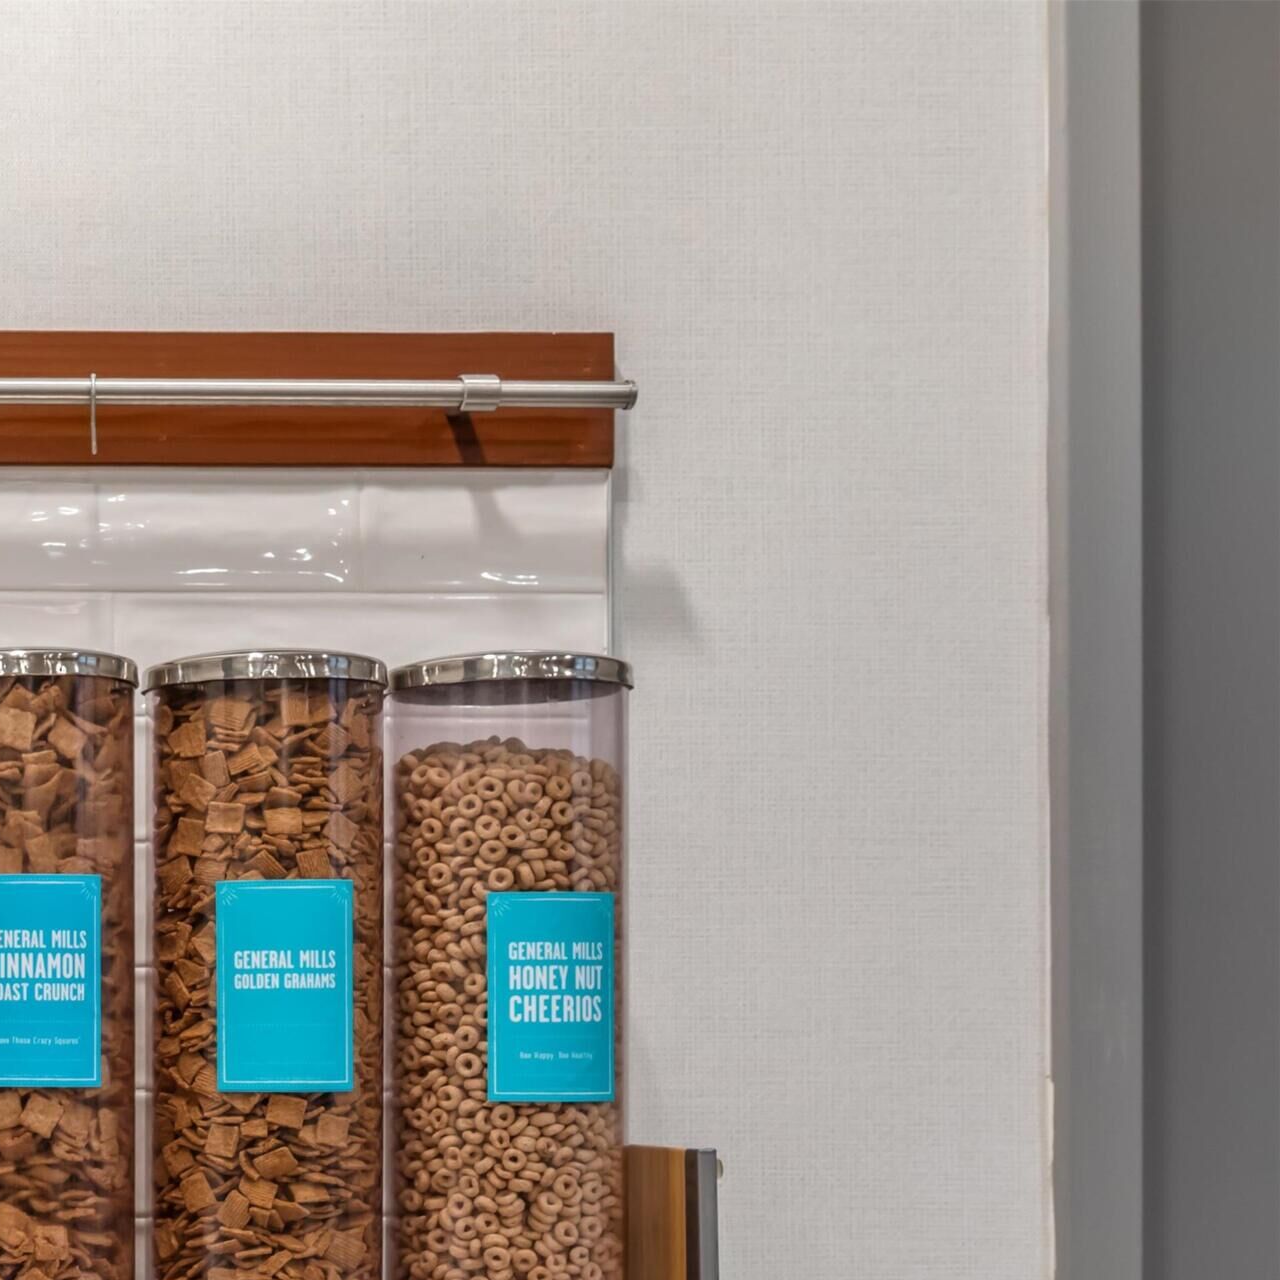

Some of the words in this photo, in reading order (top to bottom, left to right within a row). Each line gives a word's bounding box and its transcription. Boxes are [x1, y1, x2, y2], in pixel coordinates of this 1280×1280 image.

[51, 929, 87, 949] MILLS
[233, 949, 295, 970] GENERAL
[299, 950, 336, 969] MILLS
[508, 941, 568, 961] GENERAL
[572, 942, 603, 961] MILLS
[234, 972, 280, 990] GOLDEN
[283, 972, 336, 989] GRAHAMS
[508, 964, 569, 991] HONEY
[574, 965, 603, 990] NUT
[34, 982, 85, 1001] CRUNCH
[508, 994, 602, 1023] CHEERIOS
